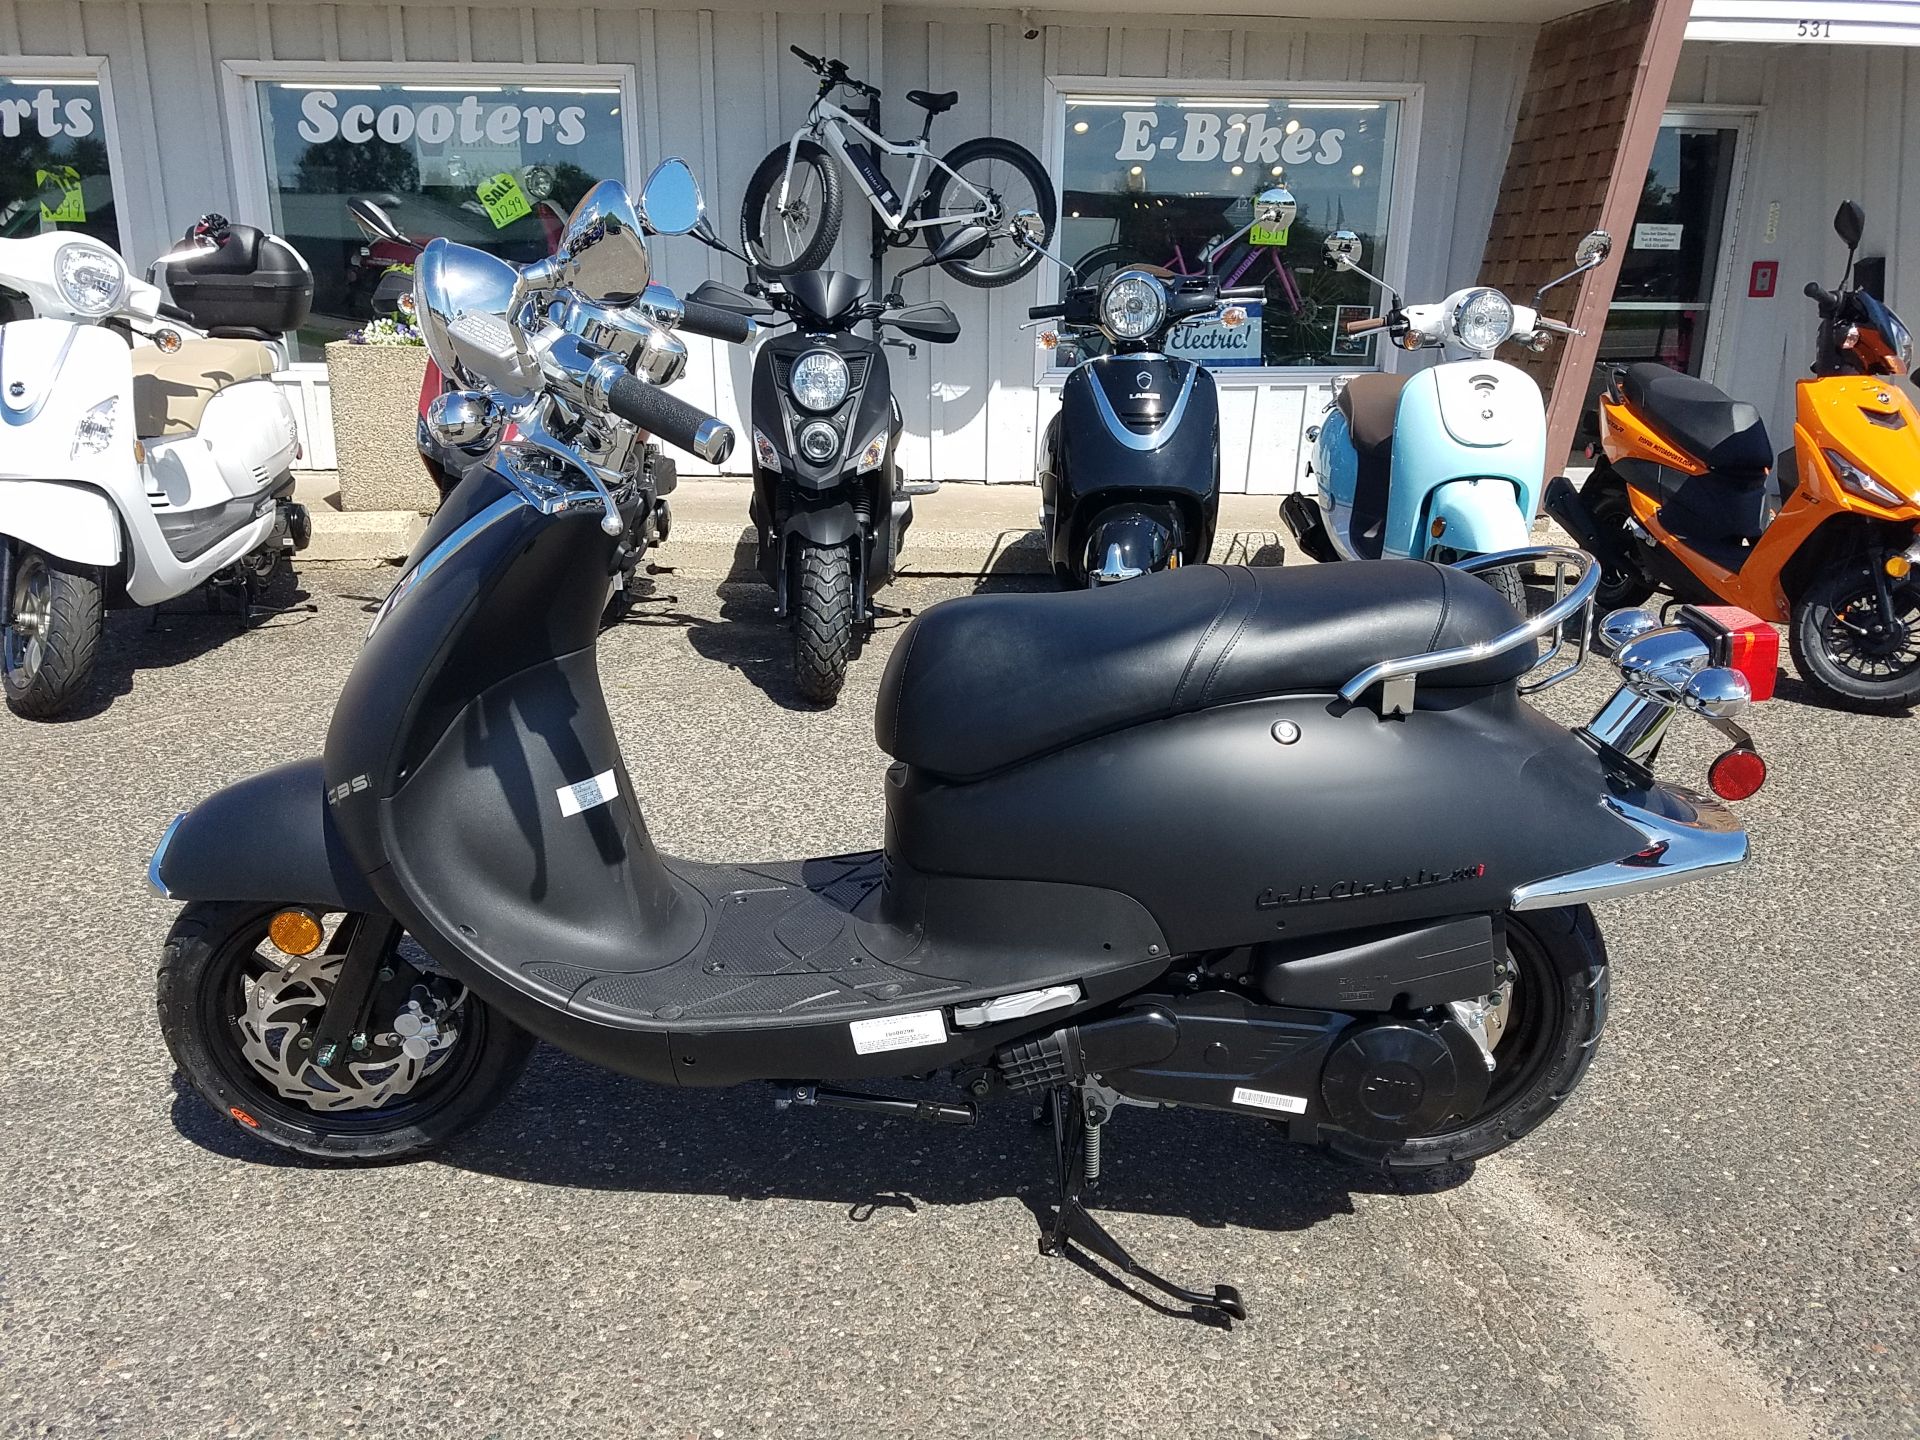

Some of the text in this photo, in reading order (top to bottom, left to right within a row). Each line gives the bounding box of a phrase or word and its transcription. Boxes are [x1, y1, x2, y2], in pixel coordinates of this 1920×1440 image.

[1797, 20, 1831, 38] 531
[0, 89, 94, 138] rts
[298, 91, 586, 145] Scooters
[1115, 111, 1345, 164] E-Bikes
[483, 179, 515, 207] SALE
[1171, 325, 1251, 350] Electric!
